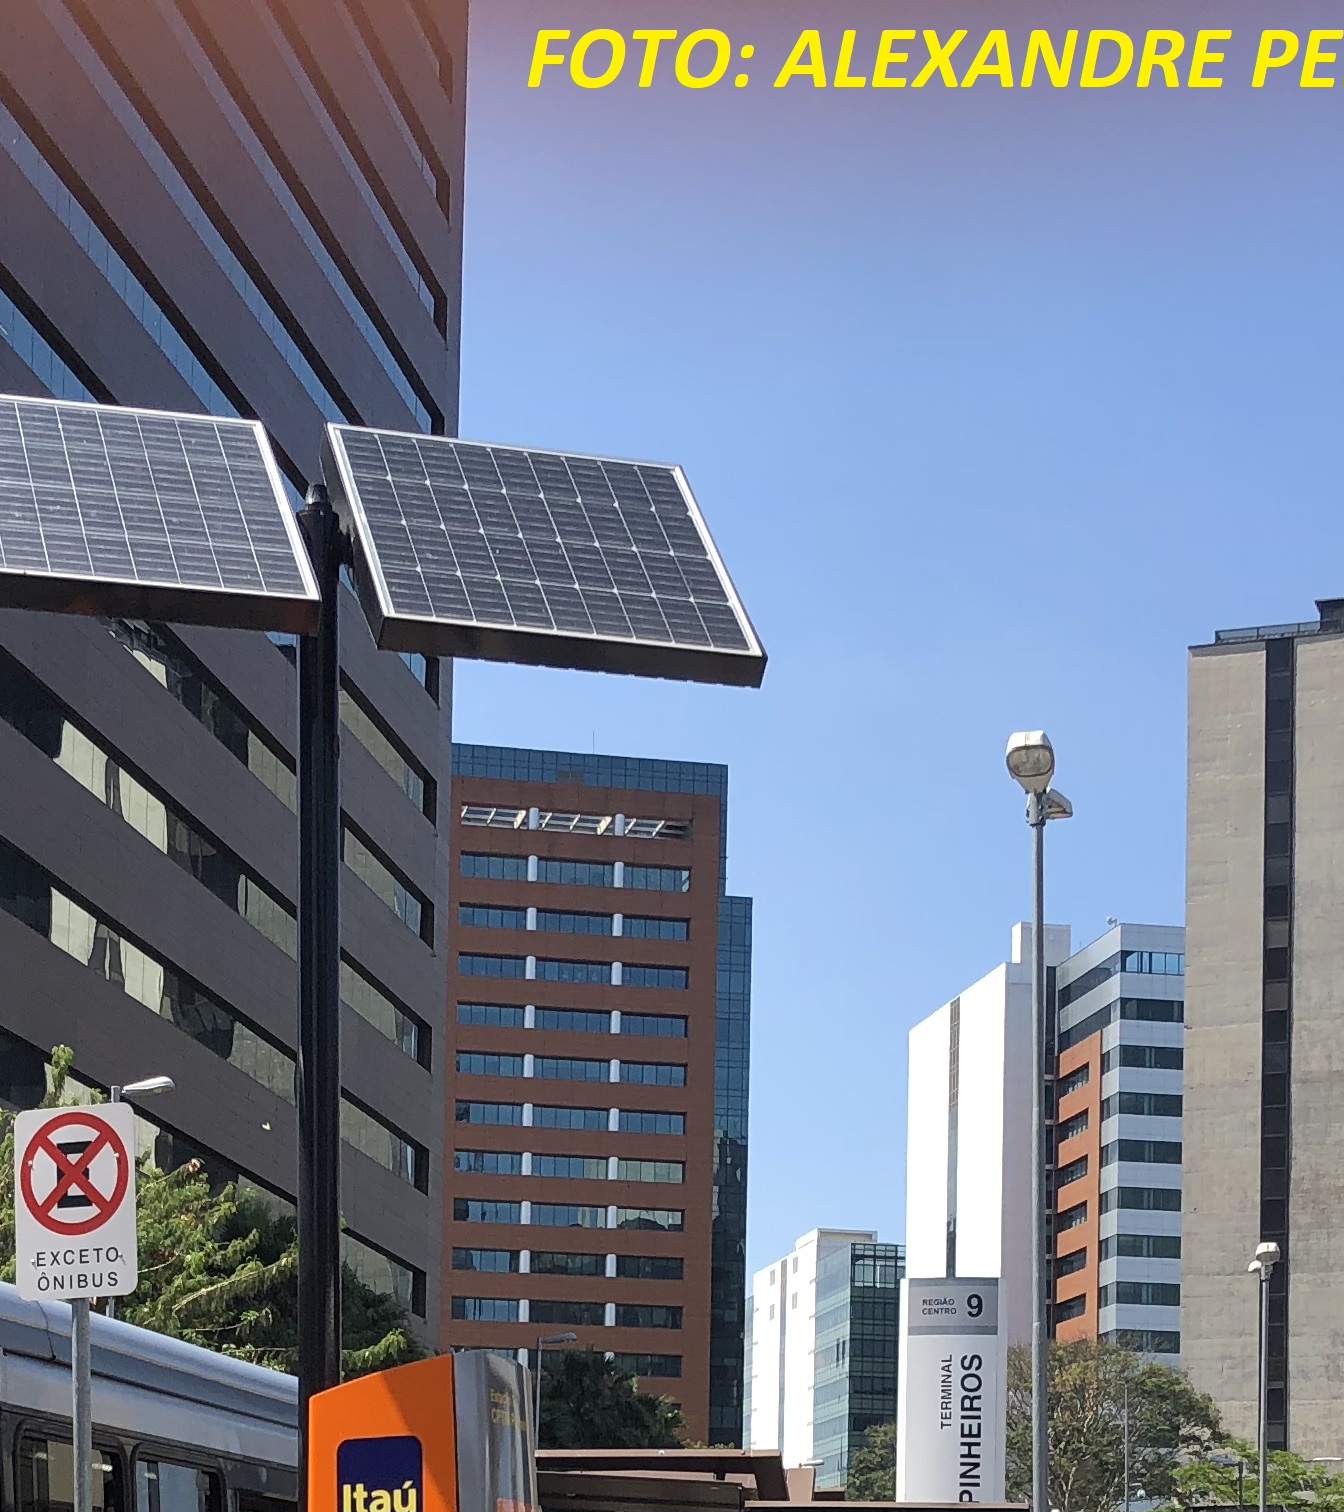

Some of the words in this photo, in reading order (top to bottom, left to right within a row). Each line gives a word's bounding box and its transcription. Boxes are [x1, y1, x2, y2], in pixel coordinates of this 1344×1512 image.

[36, 1246, 119, 1268] EXCETO
[37, 1271, 118, 1291] ÔNIBUS
[922, 1307, 957, 1315] CENTRO
[966, 1293, 983, 1318] 9
[940, 1353, 953, 1430] TERMINAL
[958, 1353, 983, 1503] PINHEIROS
